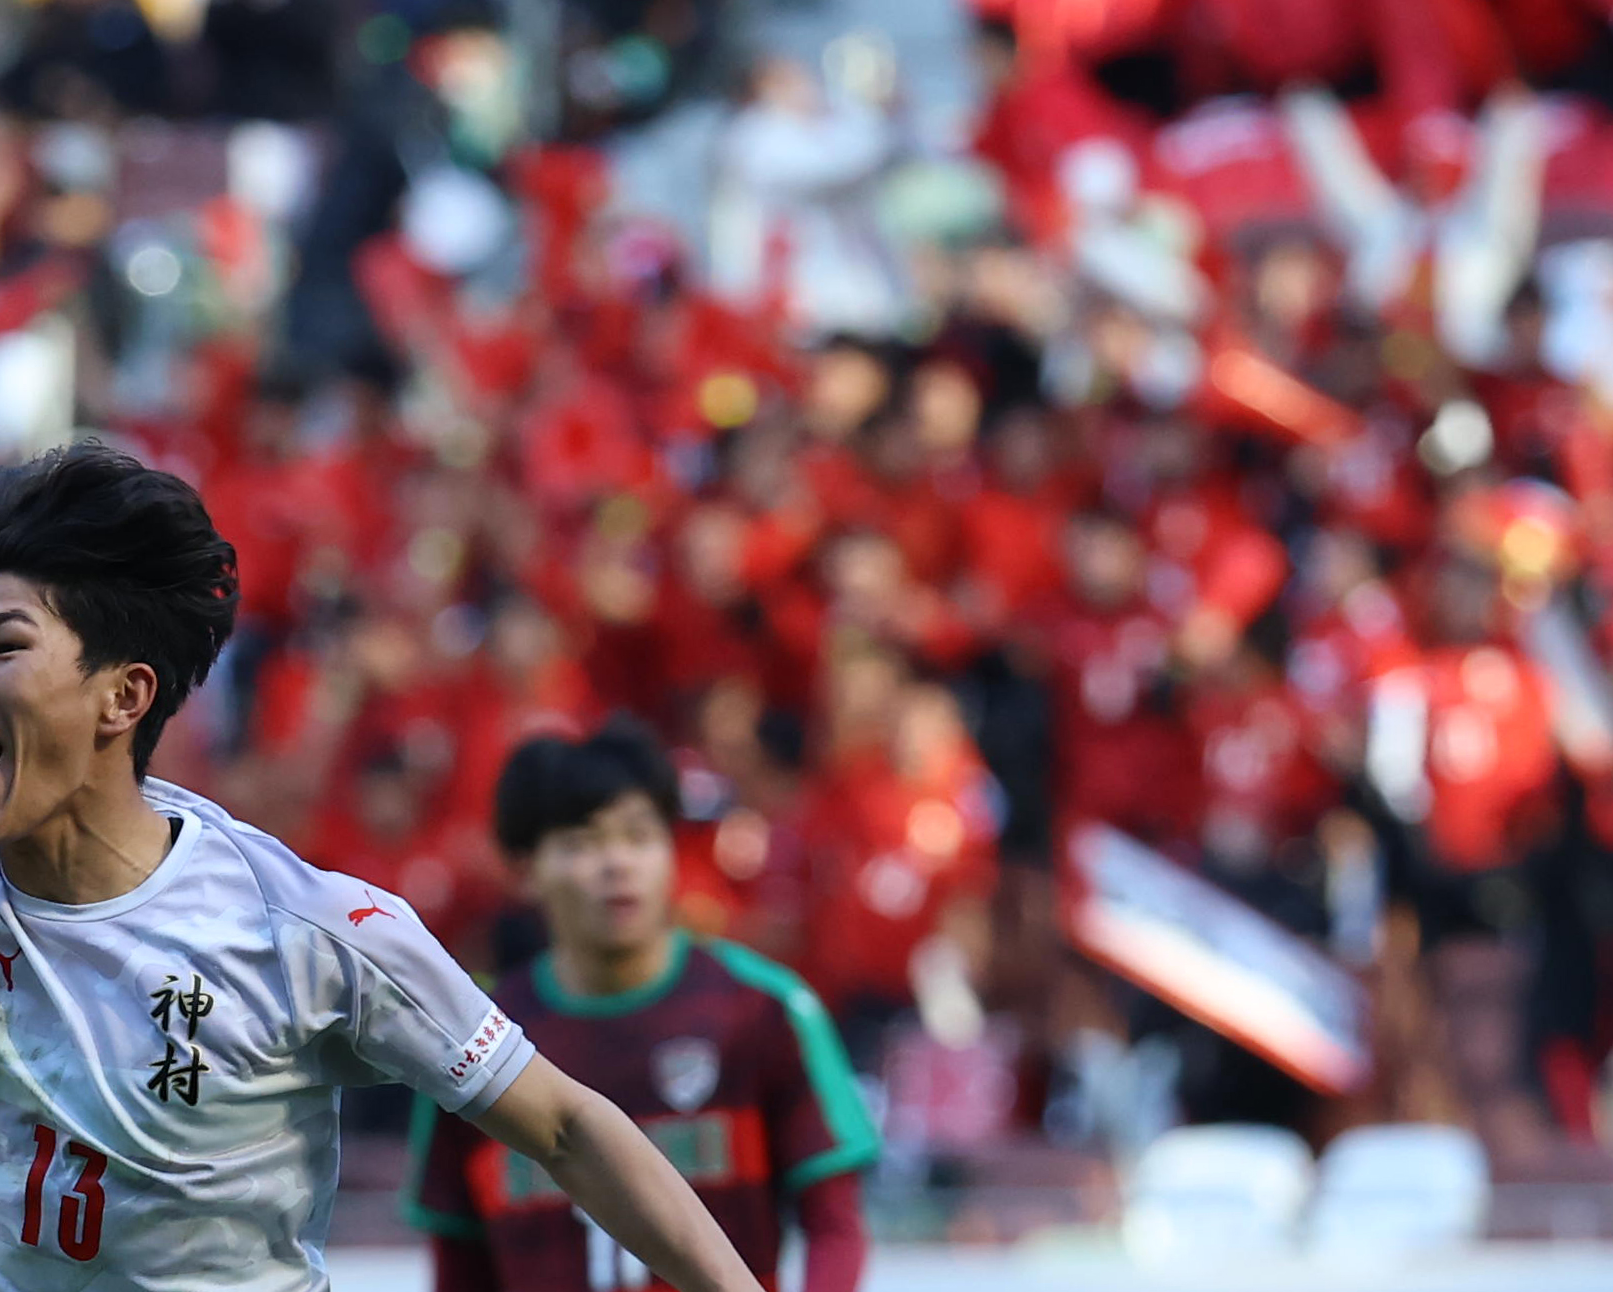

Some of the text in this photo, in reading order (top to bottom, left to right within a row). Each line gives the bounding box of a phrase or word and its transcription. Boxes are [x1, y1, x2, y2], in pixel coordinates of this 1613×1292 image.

[147, 973, 214, 1106] 神村
[449, 1007, 507, 1077] いちき串木
[20, 1123, 108, 1262] 13
